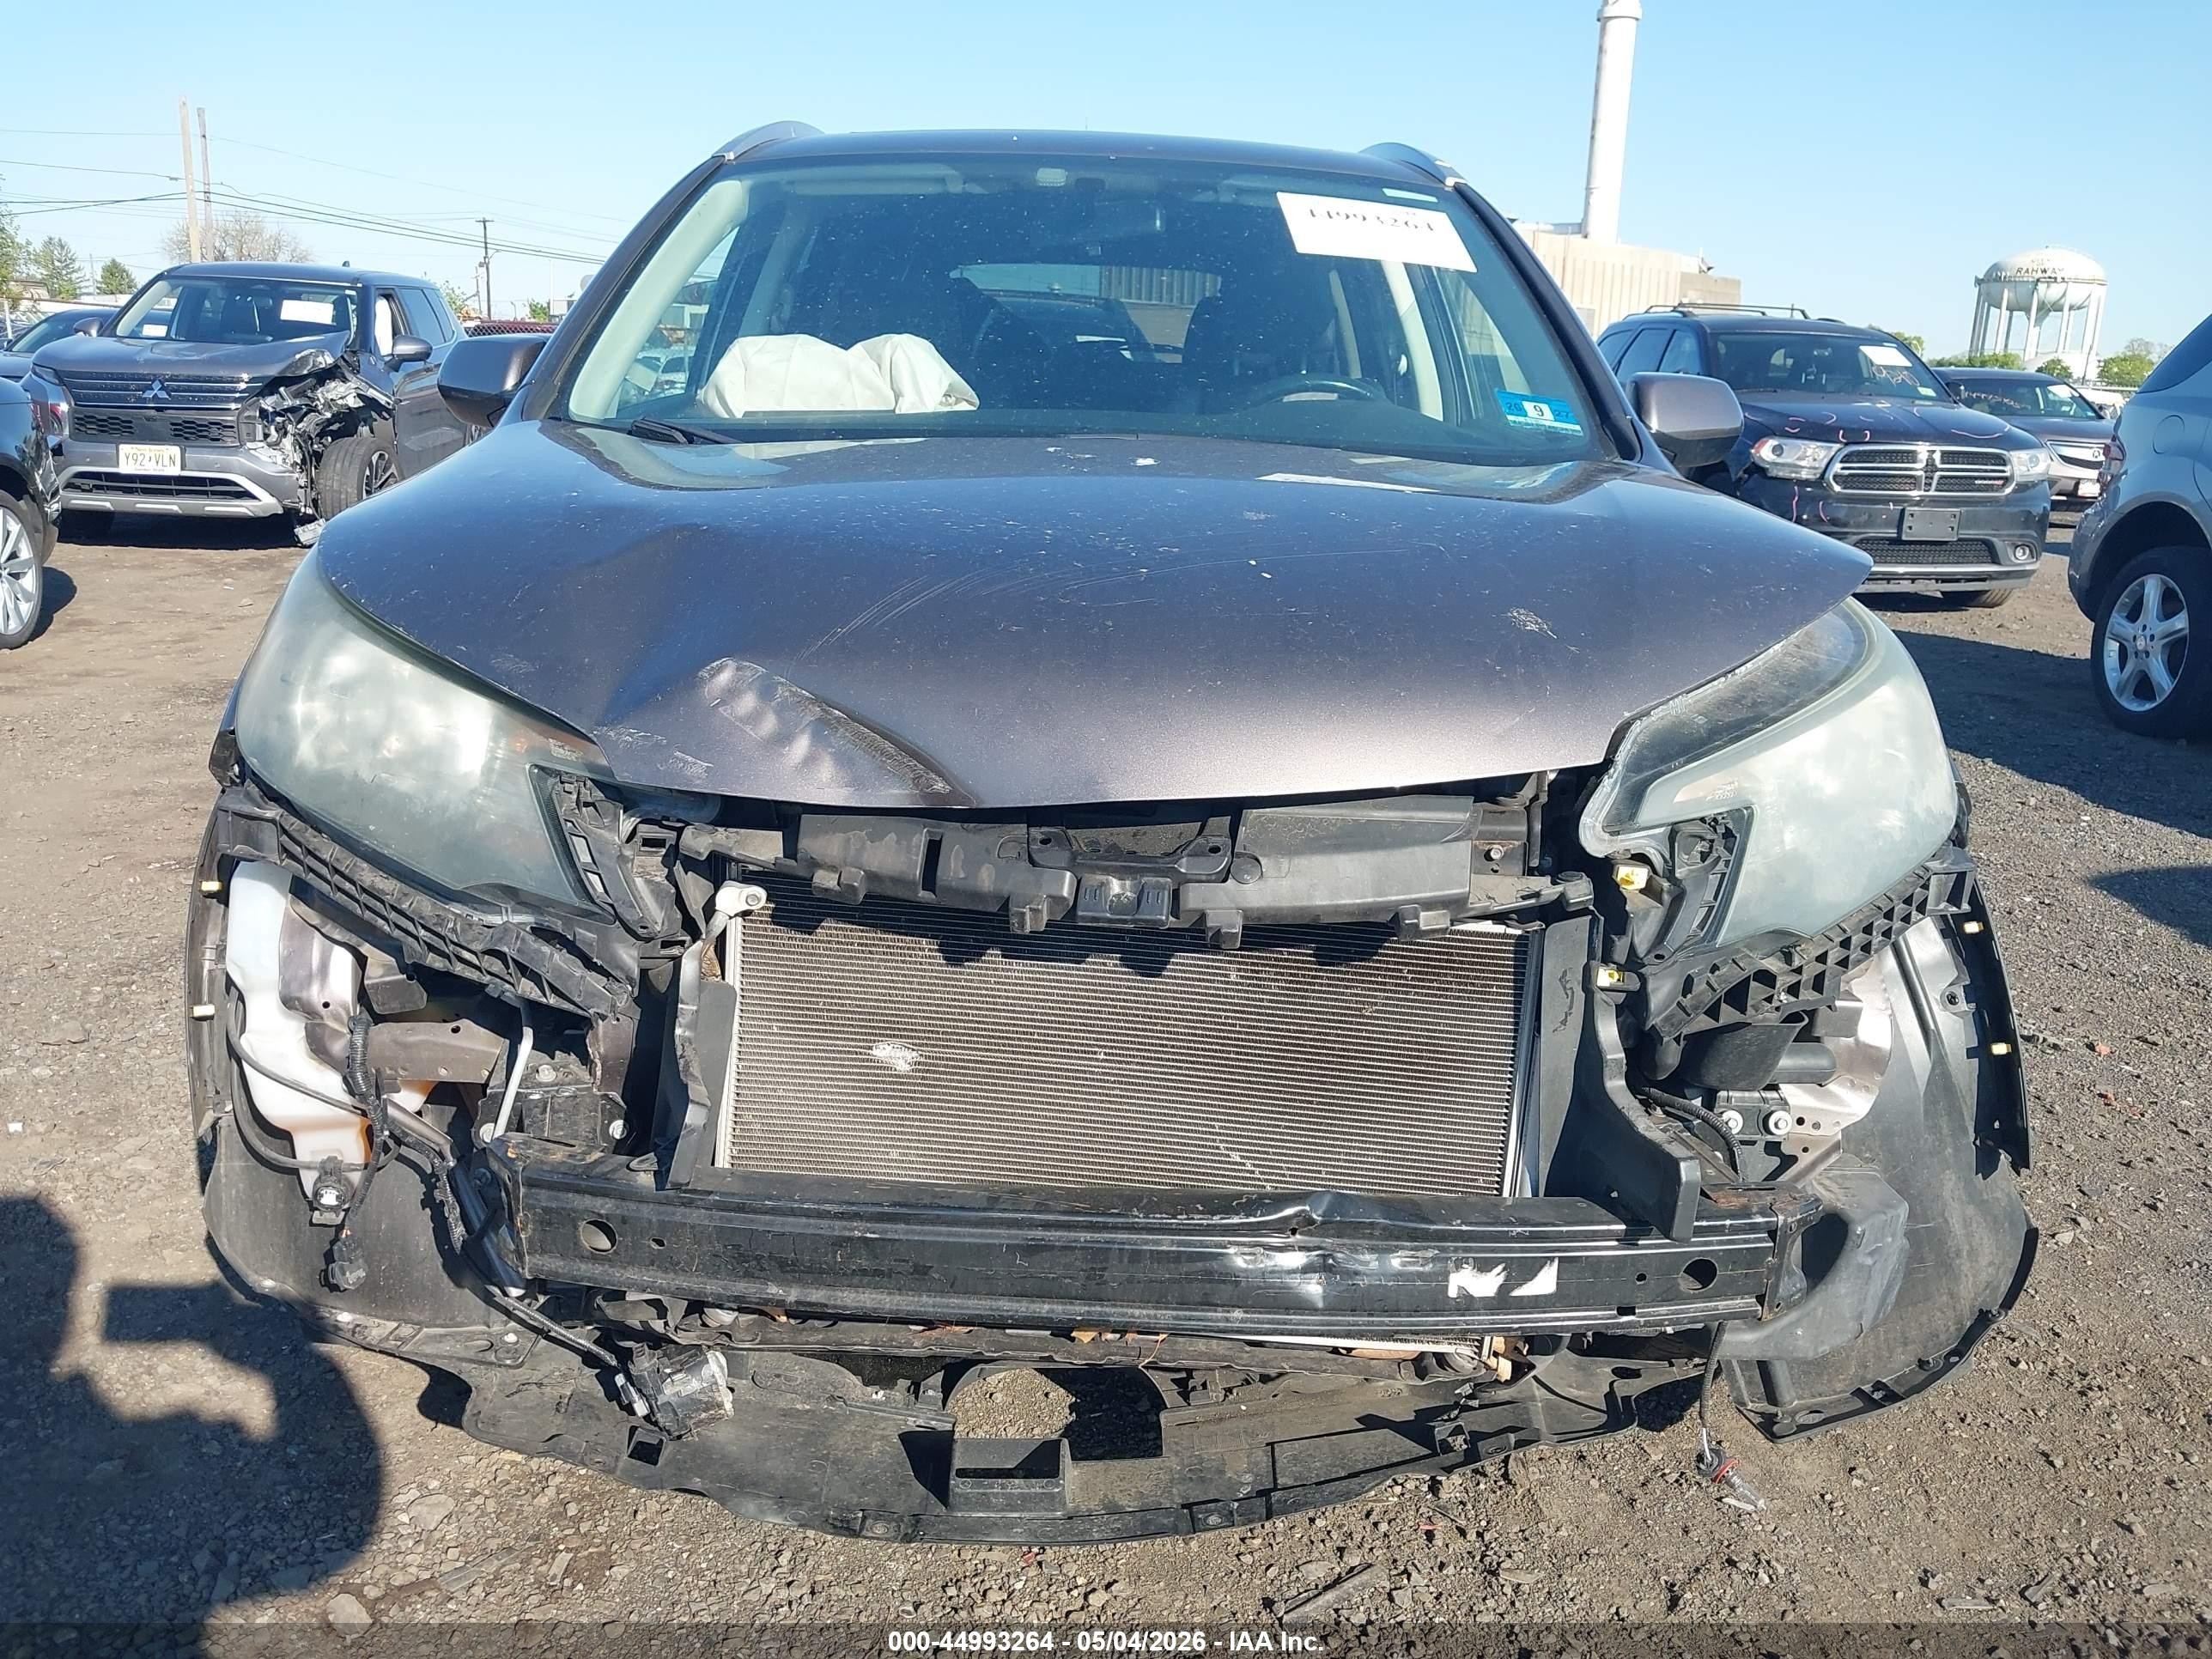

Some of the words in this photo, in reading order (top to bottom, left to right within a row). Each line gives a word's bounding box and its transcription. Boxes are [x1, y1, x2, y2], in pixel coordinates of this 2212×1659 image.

[1534, 405, 1544, 416] 9
[125, 453, 146, 466] Y92
[155, 453, 176, 467] VLN
